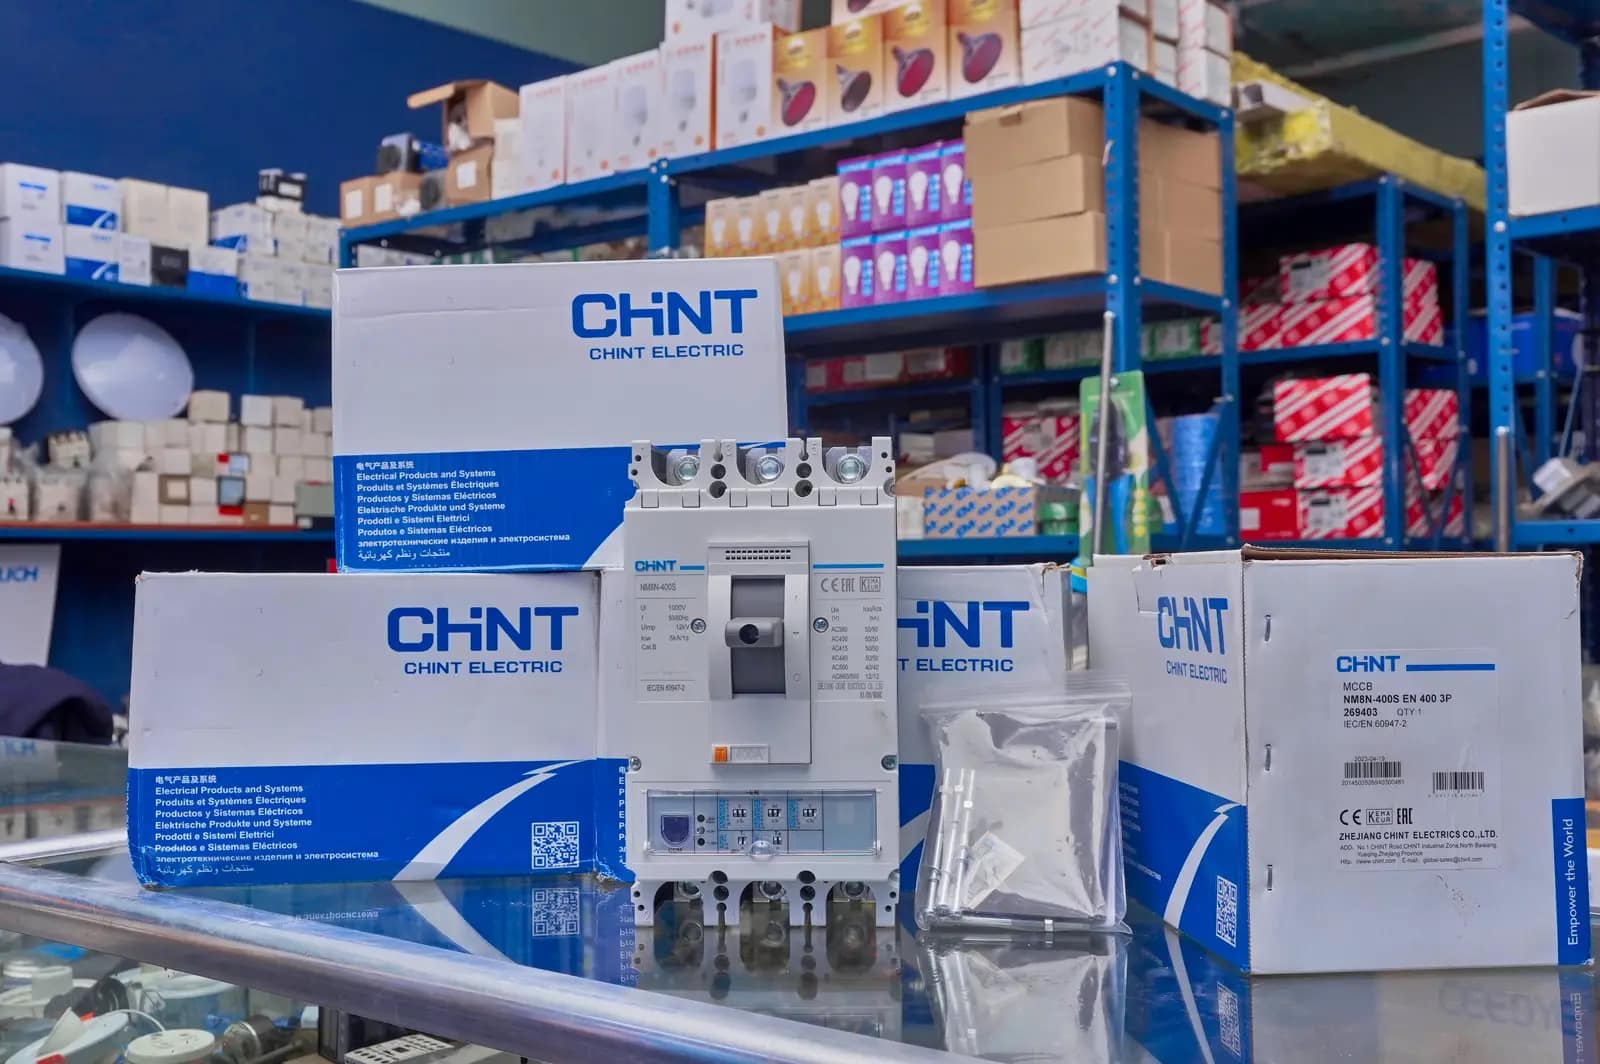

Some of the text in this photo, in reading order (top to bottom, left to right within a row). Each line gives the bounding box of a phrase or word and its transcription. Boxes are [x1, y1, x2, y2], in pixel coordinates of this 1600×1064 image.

[589, 343, 744, 360] CHINT ELECTRIC
[356, 470, 496, 481] Electrical Products and Systems
[357, 484, 394, 492] Produits
[406, 482, 448, 492] Systèmes
[451, 480, 500, 489] Électriques
[357, 495, 401, 503] Productos
[411, 493, 451, 501] Sistemas
[454, 492, 496, 500] Eléctricos
[357, 506, 406, 514] Elektrische
[408, 504, 447, 512] Produkte
[468, 503, 505, 512] Systeme
[357, 517, 393, 525] Prodotti
[402, 515, 434, 524] Sistemi
[437, 515, 470, 523] Elettrici
[357, 528, 397, 536] Produtos
[407, 527, 447, 535] Sistemas
[449, 525, 493, 533] Eléctricos
[403, 660, 563, 675] CHINT ELECTRIC
[916, 659, 1014, 672] ELECTRIC
[1166, 660, 1228, 684] CHINT ELECTRIC
[1343, 682, 1373, 692] MCCB
[1343, 694, 1453, 704] NM8N-400S EN 400 3P
[1344, 708, 1378, 717] 269403
[1343, 719, 1407, 728] IEC/EN 60947-2
[155, 775, 217, 784] 电气产品及系统
[155, 784, 304, 795] Electrical Products and Systems
[155, 795, 307, 807] Produits et Systèmes Électriques
[155, 807, 304, 819] Productos y Sistemas Eléctricos
[155, 818, 312, 830] Elektrische Produkte und Systeme
[155, 832, 192, 841] Prodotti
[202, 832, 237, 840] Sistemi
[239, 831, 275, 839] Elettrici
[1339, 832, 1382, 840] ZHEJIANG
[1383, 831, 1409, 840] CHINT
[1413, 830, 1460, 839] ELECTRICS
[155, 844, 197, 853] Produtos
[207, 843, 250, 851] Sistemas
[252, 842, 298, 850] Eléctricos
[1562, 818, 1580, 945] Empower the World
